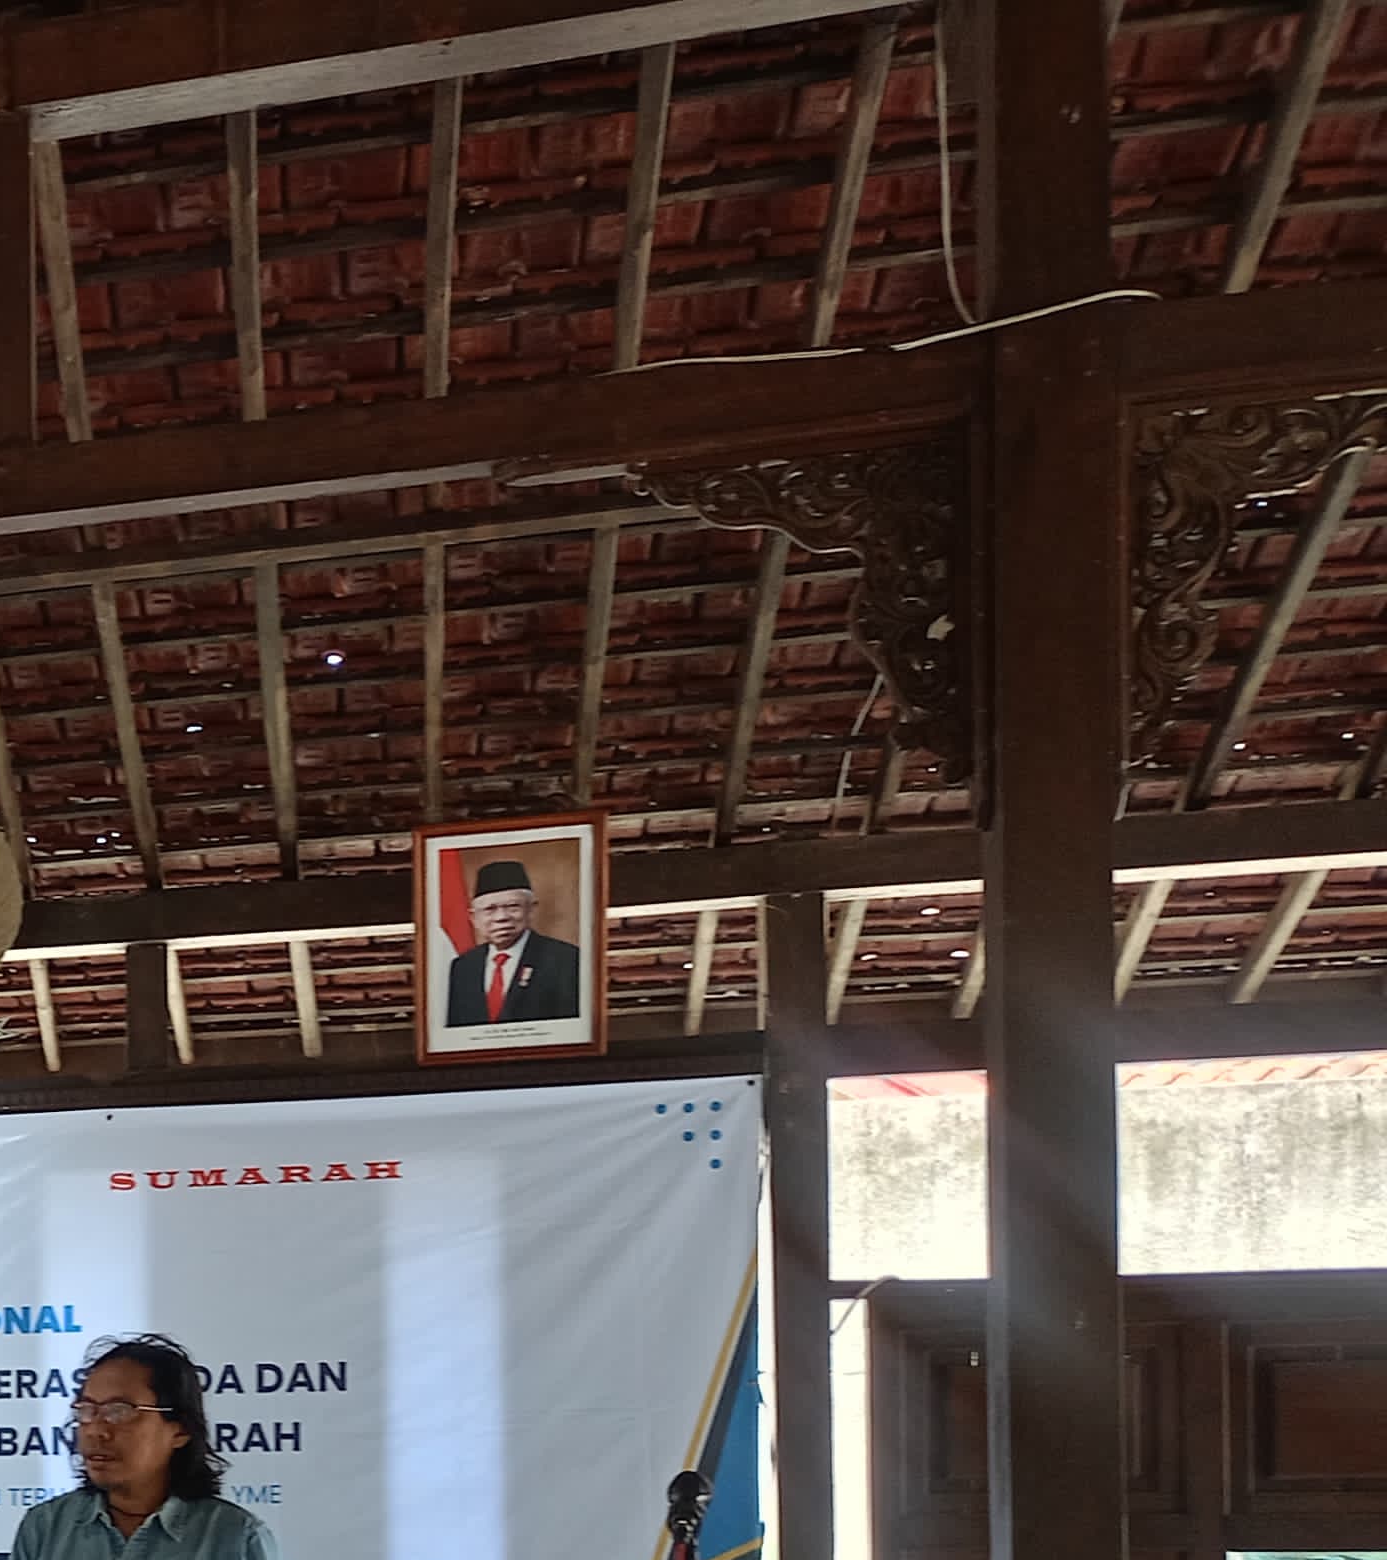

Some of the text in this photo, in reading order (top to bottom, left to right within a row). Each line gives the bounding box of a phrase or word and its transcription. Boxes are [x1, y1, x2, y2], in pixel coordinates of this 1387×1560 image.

[109, 1160, 403, 1191] SUMARAH
[256, 1361, 348, 1393] DAN
[231, 1485, 283, 1504] YME
